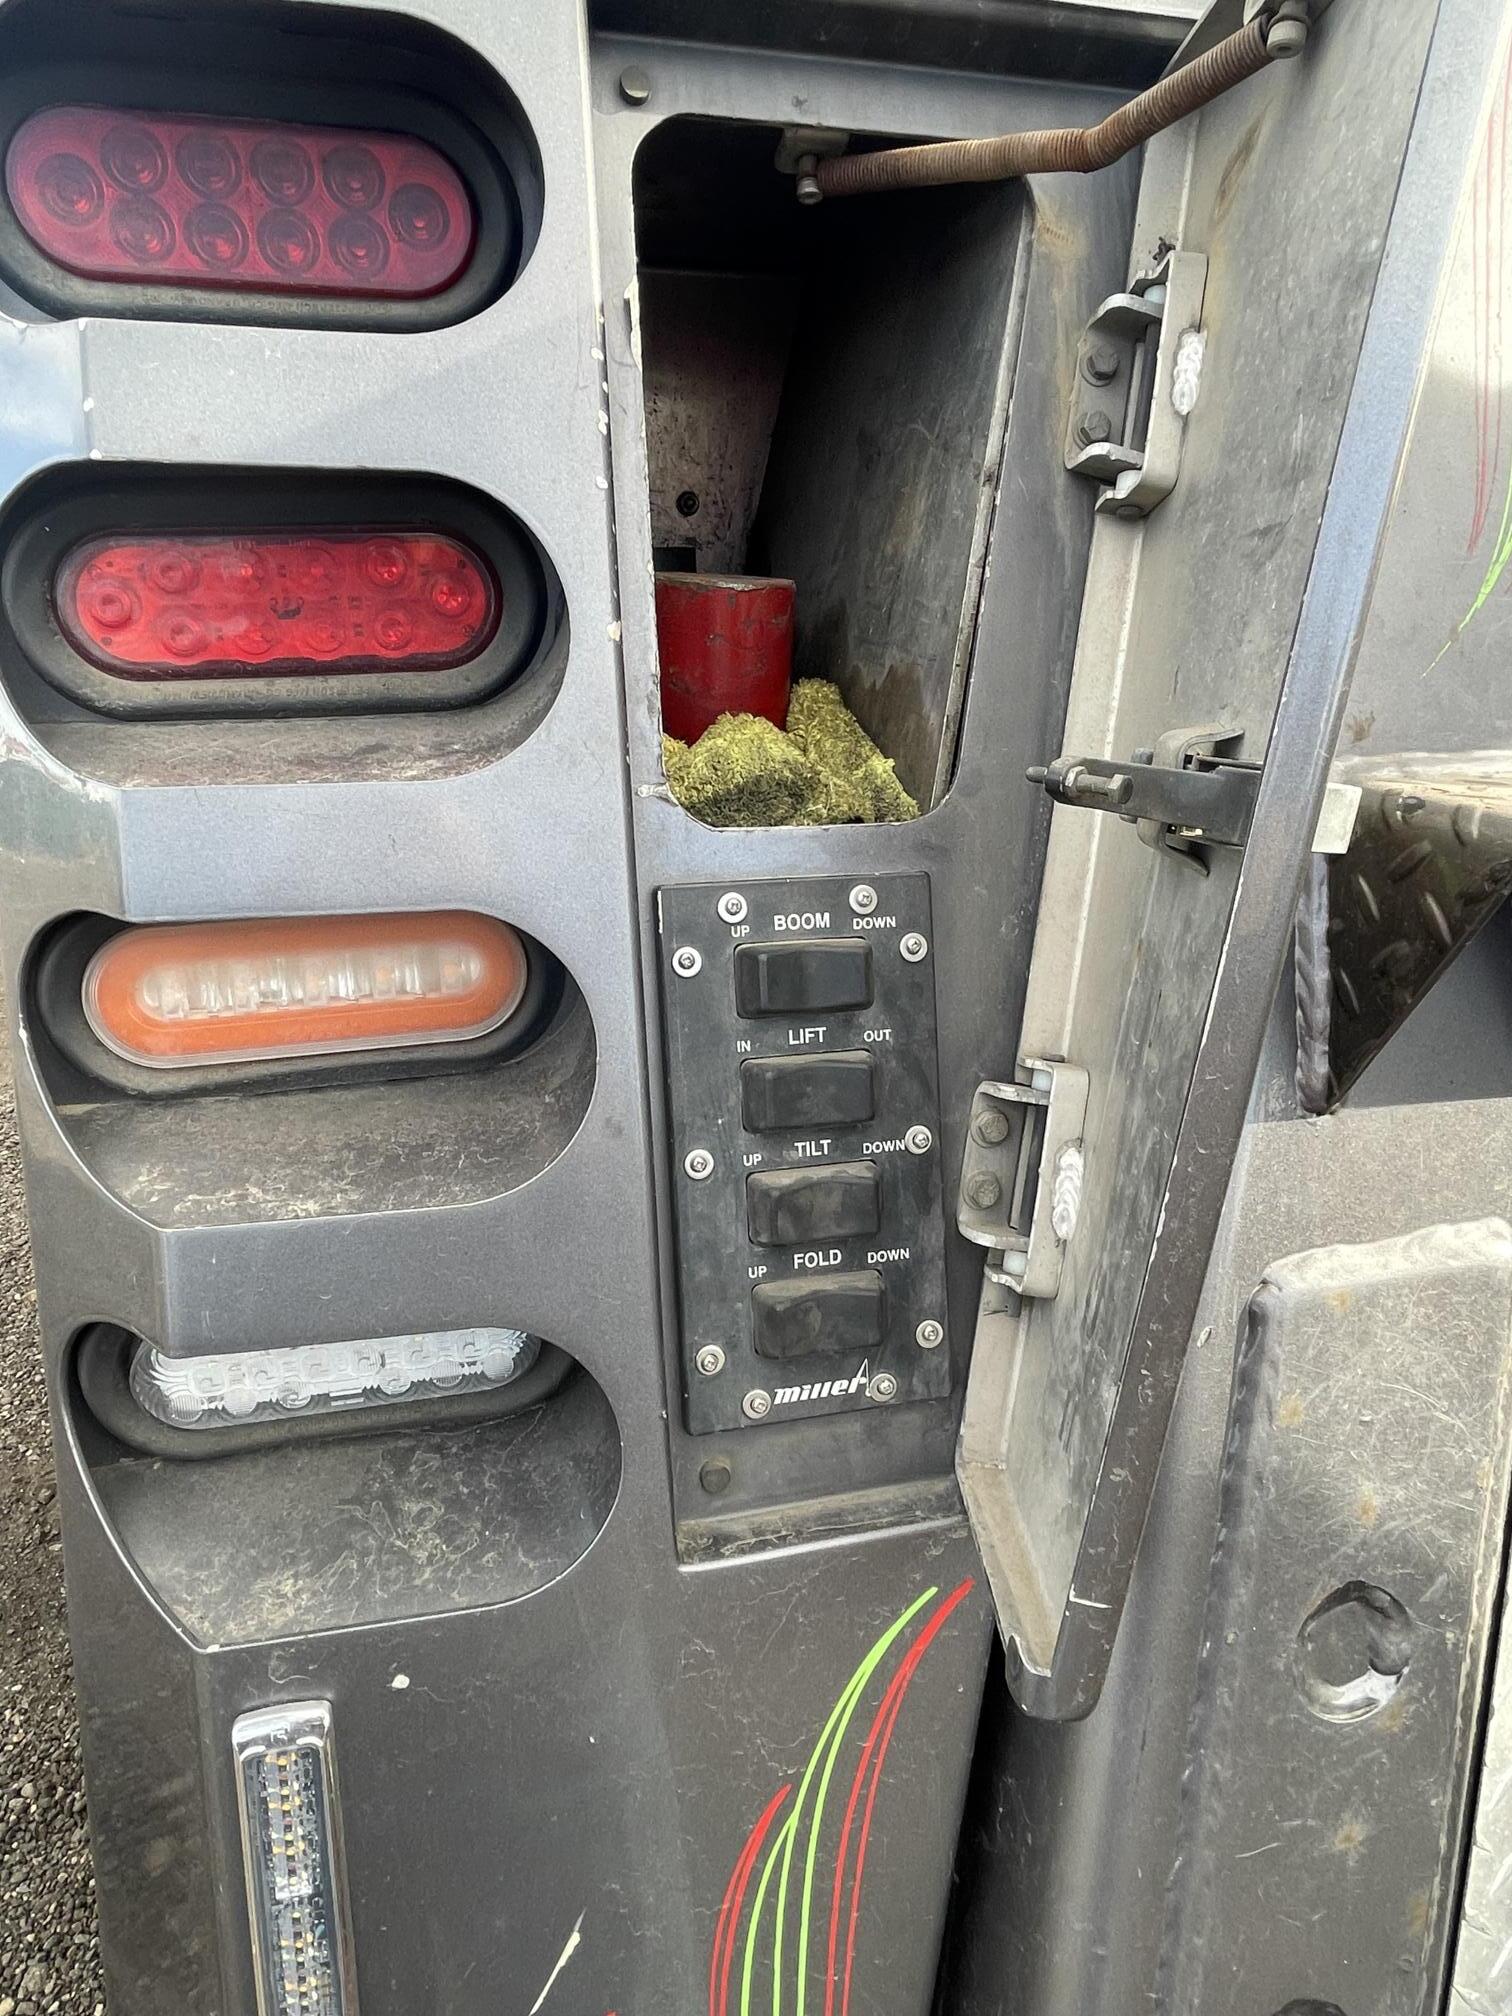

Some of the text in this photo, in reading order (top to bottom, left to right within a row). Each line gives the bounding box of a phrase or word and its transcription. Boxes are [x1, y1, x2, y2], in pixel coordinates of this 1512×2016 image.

[731, 912, 896, 938] UP BOOM DOWN
[736, 1026, 892, 1053] IN LIFT OUT
[743, 1139, 906, 1167] UP TILT DOWN
[748, 1248, 910, 1279] UP FOLD DOWN
[773, 1375, 868, 1405] miller
